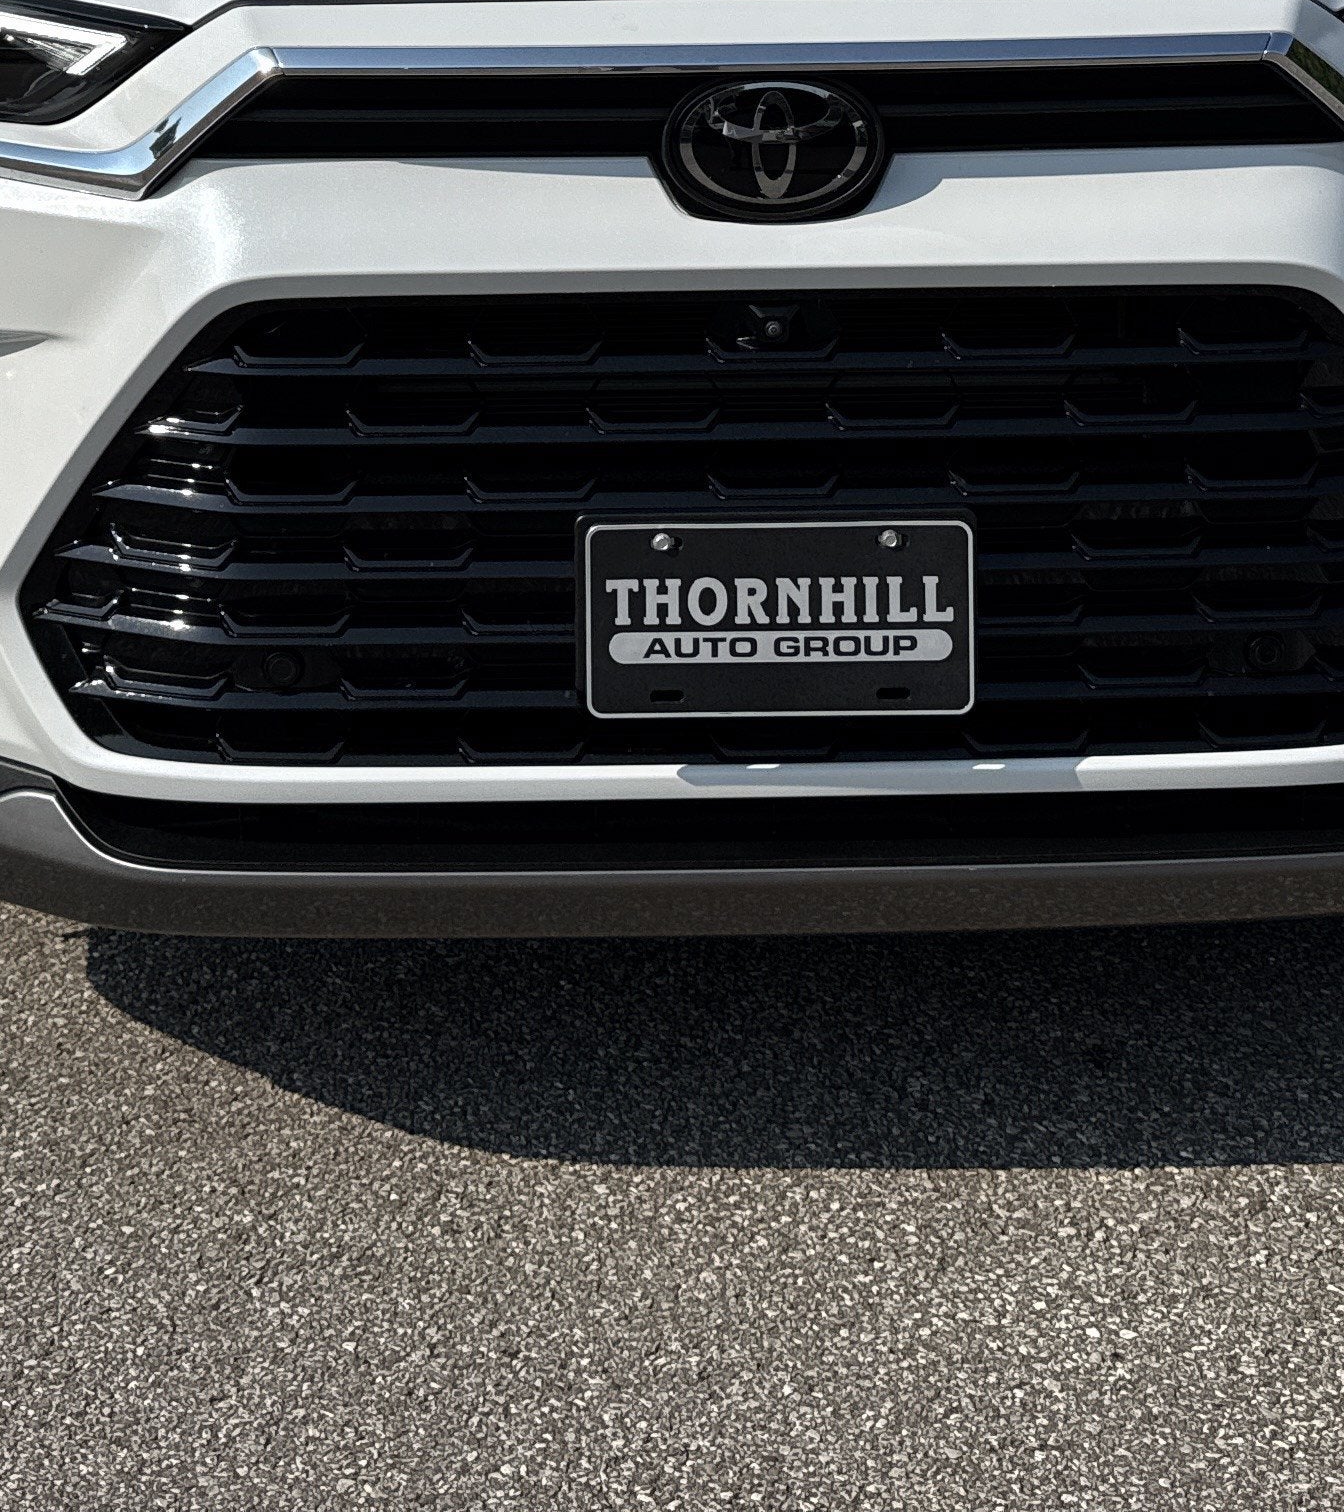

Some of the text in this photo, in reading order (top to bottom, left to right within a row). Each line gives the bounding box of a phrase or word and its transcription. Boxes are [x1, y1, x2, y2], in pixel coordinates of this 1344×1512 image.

[605, 575, 954, 626] THORNHILL
[642, 634, 918, 659] AUTO GROUP
